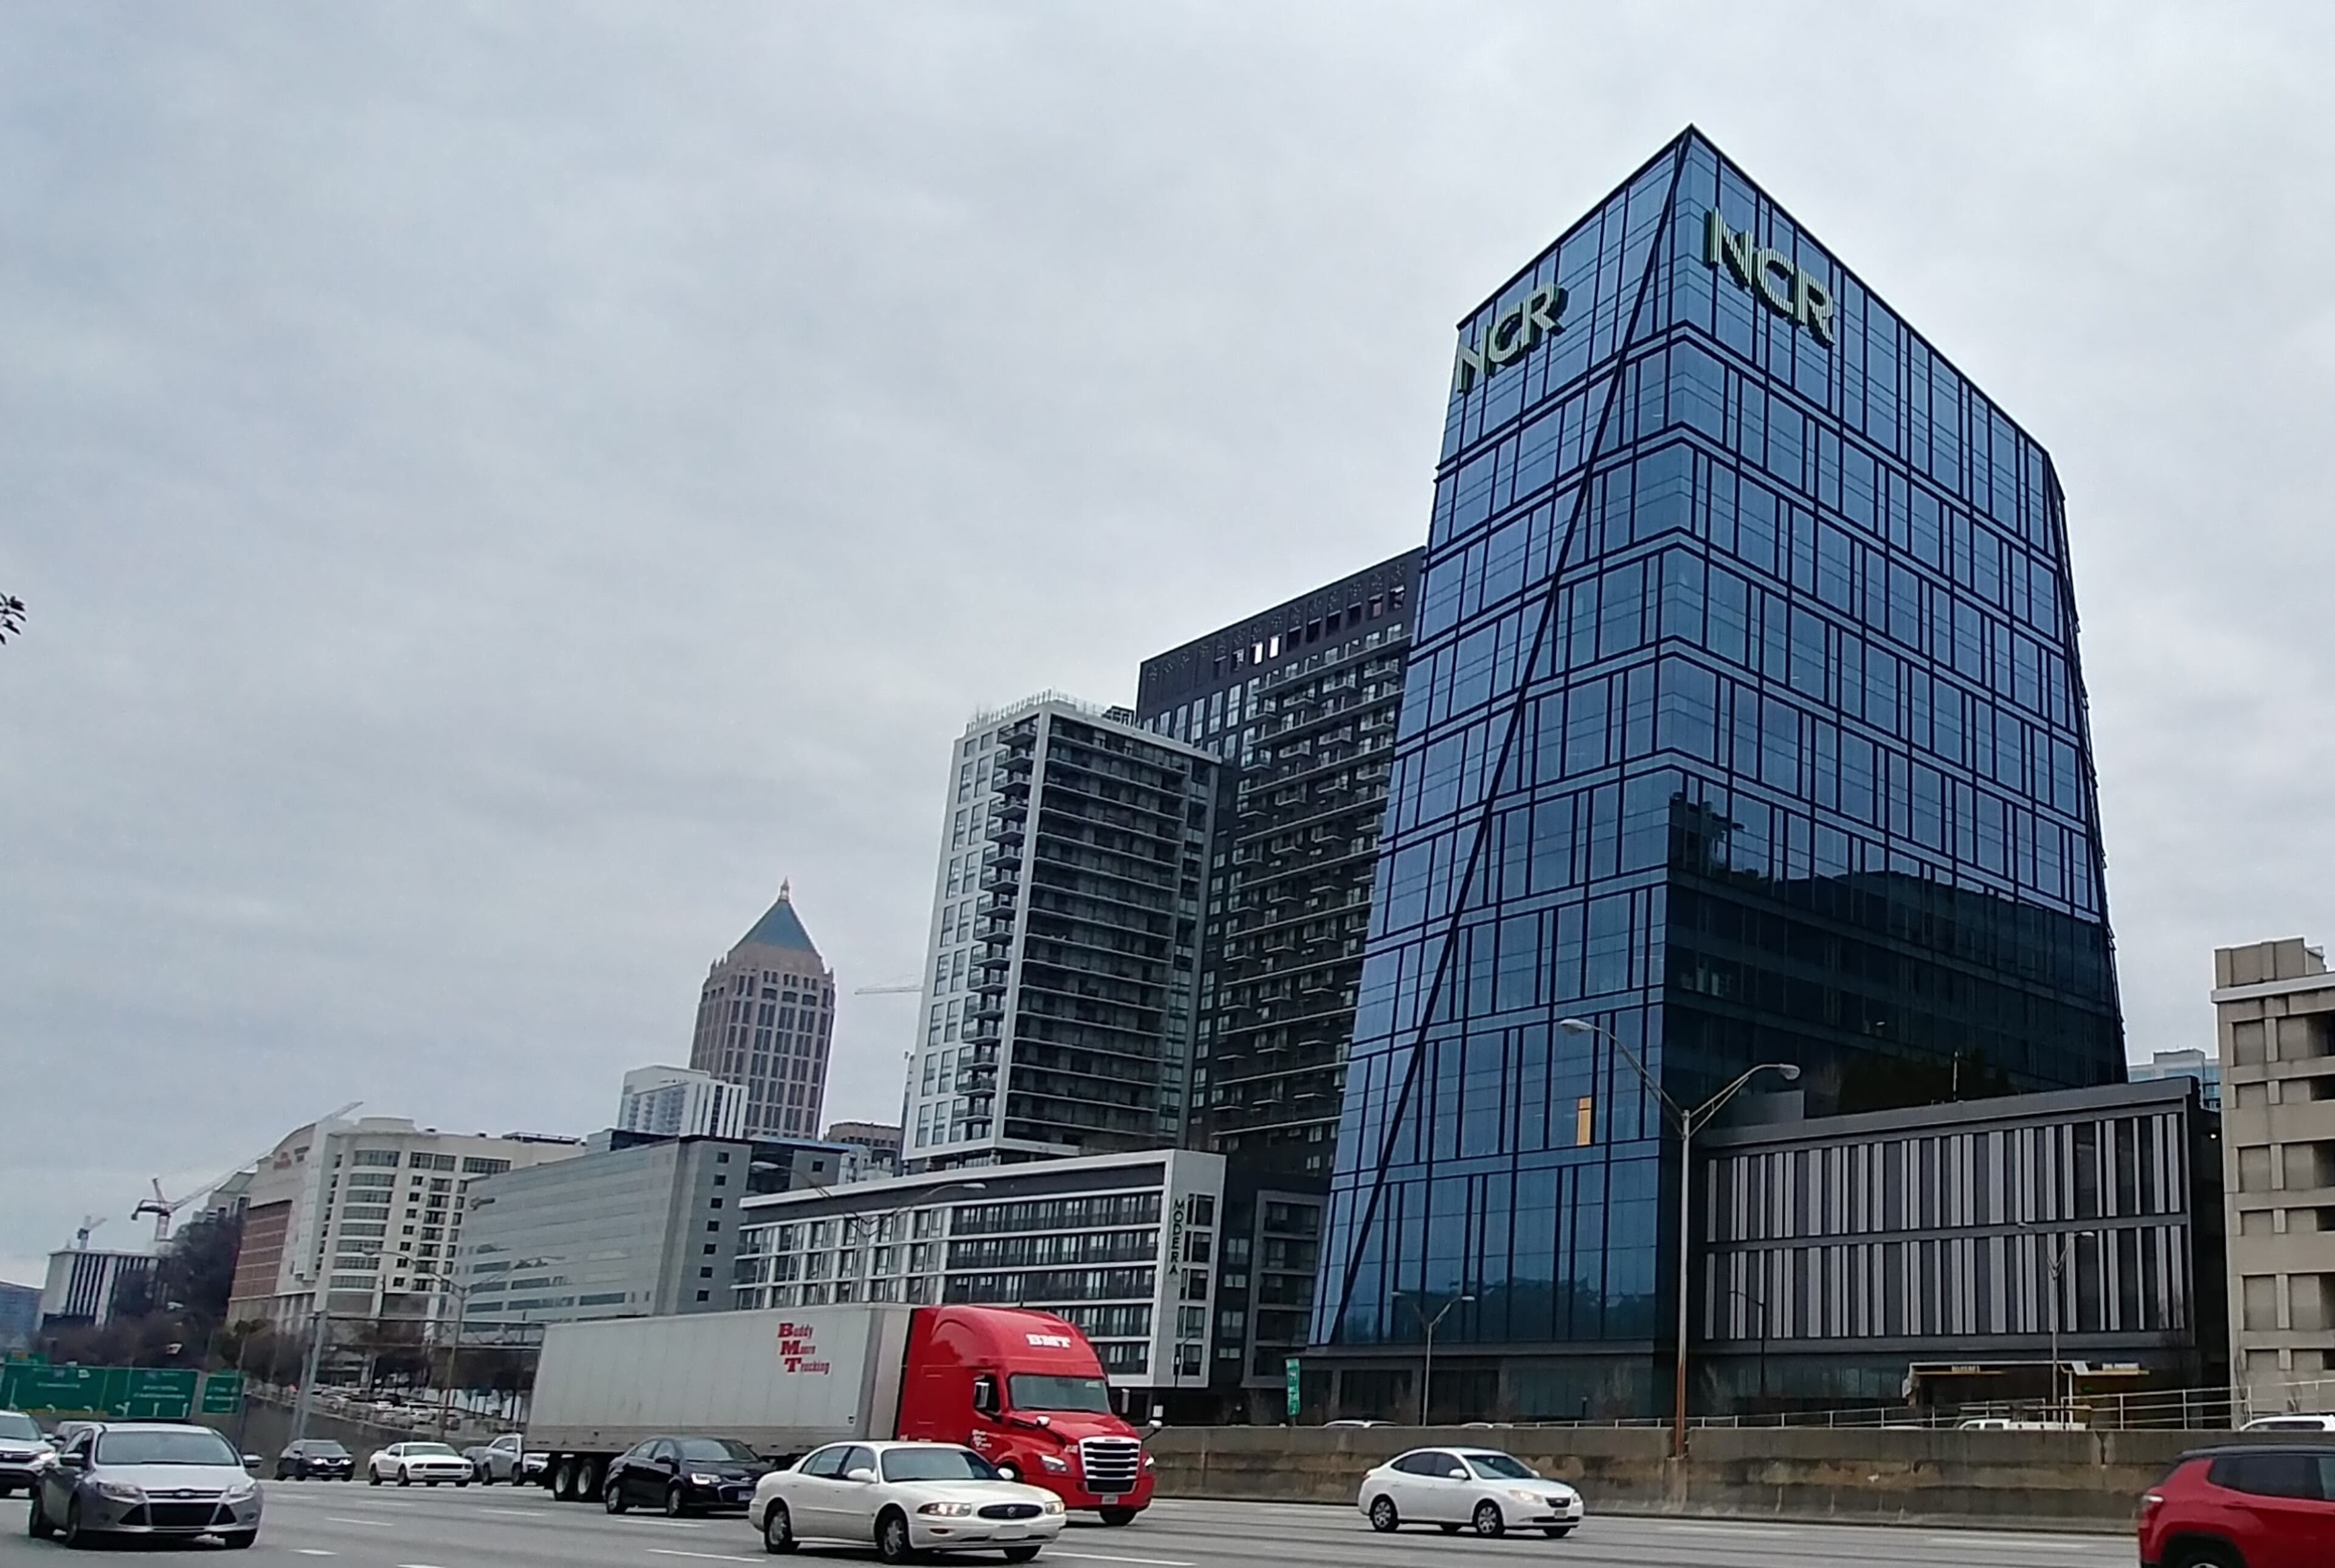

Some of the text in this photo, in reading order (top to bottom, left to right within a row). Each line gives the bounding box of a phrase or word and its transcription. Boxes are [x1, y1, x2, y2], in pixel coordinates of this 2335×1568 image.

[1704, 206, 1835, 347] NCR
[1456, 282, 1566, 393] NCR
[1169, 1198, 1185, 1275] MODERA
[778, 1322, 814, 1339] Buddy
[1025, 1333, 1071, 1348] BMT
[784, 1357, 830, 1375] Trucking
